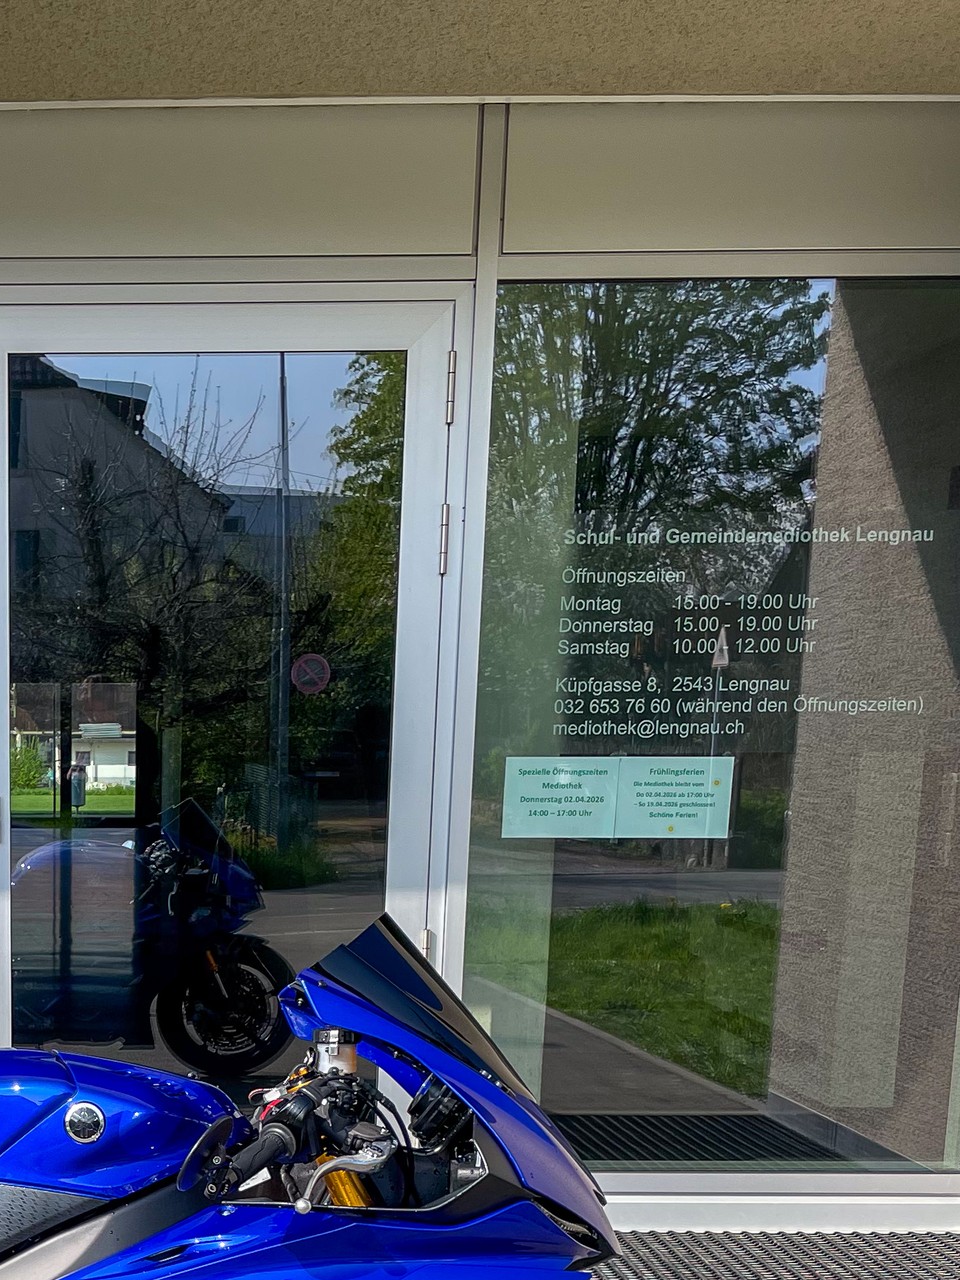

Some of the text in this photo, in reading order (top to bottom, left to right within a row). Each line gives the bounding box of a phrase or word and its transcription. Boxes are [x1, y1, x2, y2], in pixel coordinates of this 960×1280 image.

[564, 526, 935, 546] Schul- und Gemeindemediothek Lengnau
[561, 565, 686, 587] Öffnungszeiten
[559, 595, 622, 615] Montag
[674, 594, 720, 610] 15.00
[737, 593, 783, 610] 19.00
[789, 593, 820, 610] Uhr
[558, 617, 654, 636] Donnerstag
[673, 616, 720, 632] 15.00
[736, 615, 783, 632] 19.00
[788, 615, 819, 632] Uhr
[557, 639, 631, 658] Samstag
[671, 638, 718, 654] 10.00
[734, 637, 781, 654] 12.00
[786, 637, 817, 653] Uhr
[554, 676, 791, 696] Küpfgasse 8, 2543 Lengnau
[553, 694, 925, 717] 032 653 76 60 (während den Öffnungszeiten)
[552, 719, 745, 739] mediothek@lengnau.ch
[518, 767, 609, 777] Spezielle Öffnungszeiten
[649, 767, 705, 777] Frühlingsferien
[541, 782, 583, 790] Mediothek
[519, 795, 605, 804] Donnerstag 02.04.2026
[528, 809, 549, 817] 14:00
[556, 809, 577, 817] 17:00
[578, 809, 593, 817] Uhr
